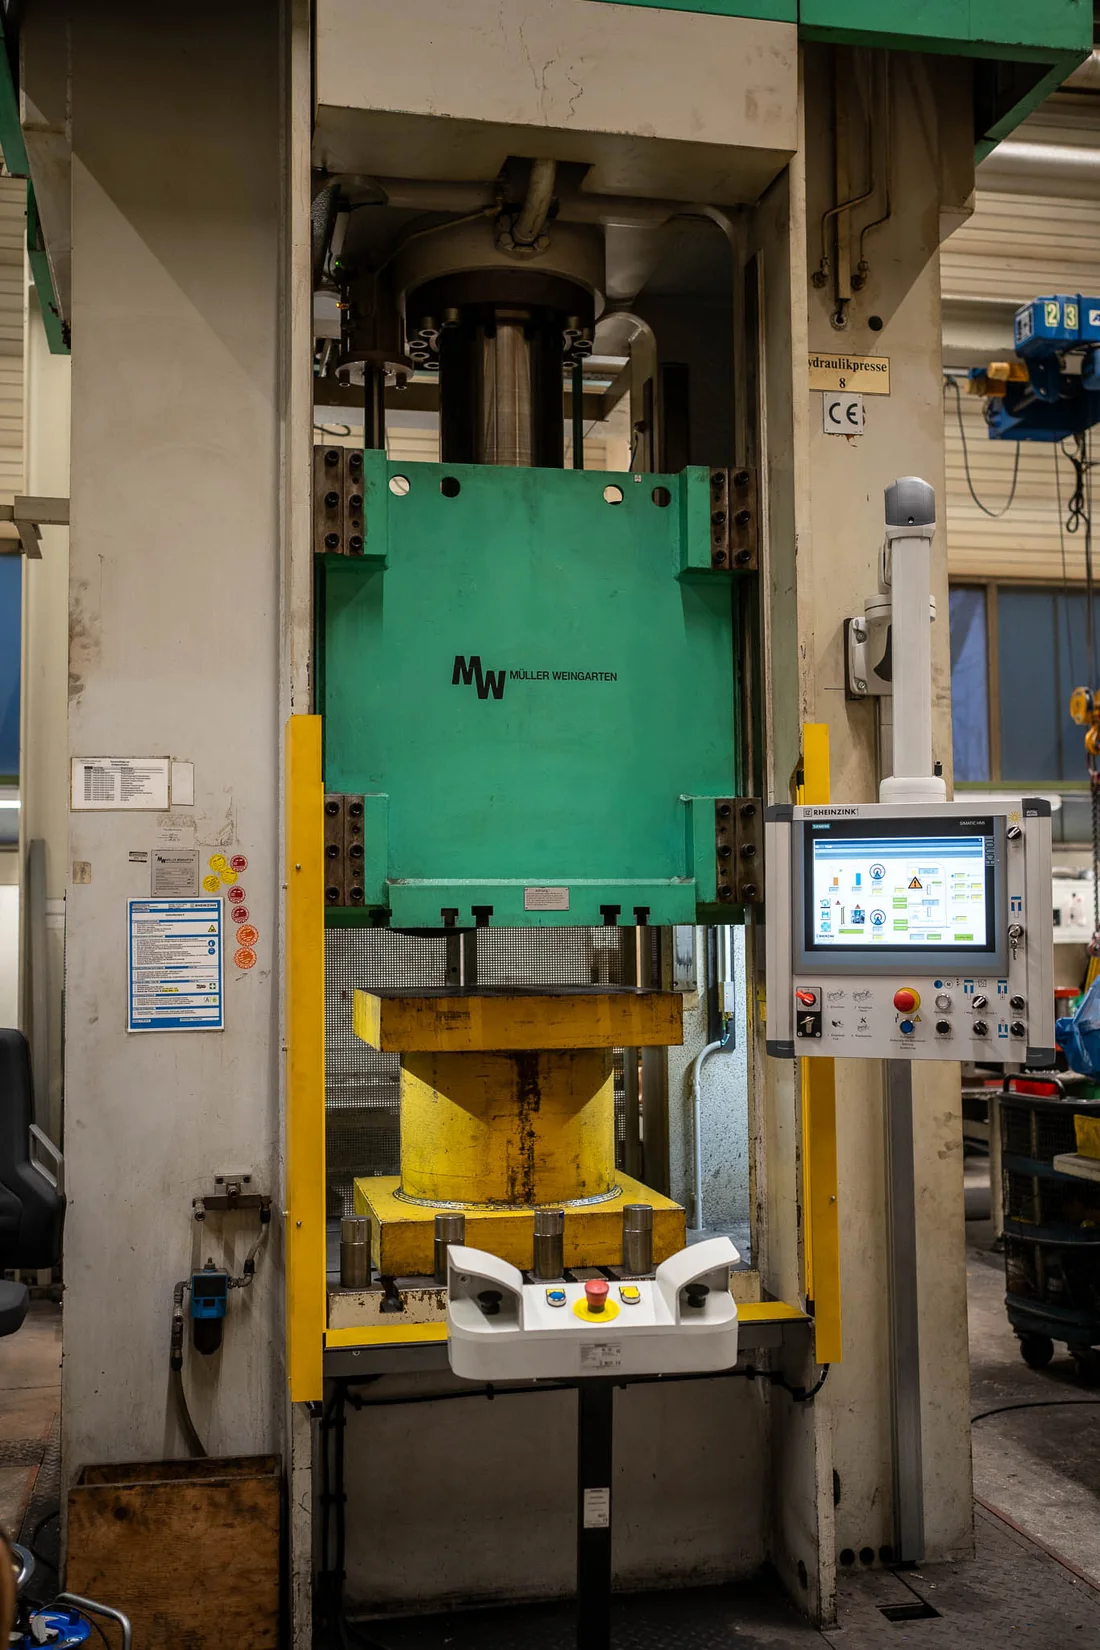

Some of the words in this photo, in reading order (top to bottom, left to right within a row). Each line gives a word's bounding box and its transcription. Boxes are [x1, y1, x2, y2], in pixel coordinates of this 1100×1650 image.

[1047, 303, 1057, 324] 2
[1066, 306, 1076, 327] 3
[839, 377, 846, 389] 8
[828, 402, 859, 426] CE
[509, 668, 550, 681] MÜLLER
[552, 671, 618, 682] WEINGARTEN
[985, 836, 995, 867] TOUCH
